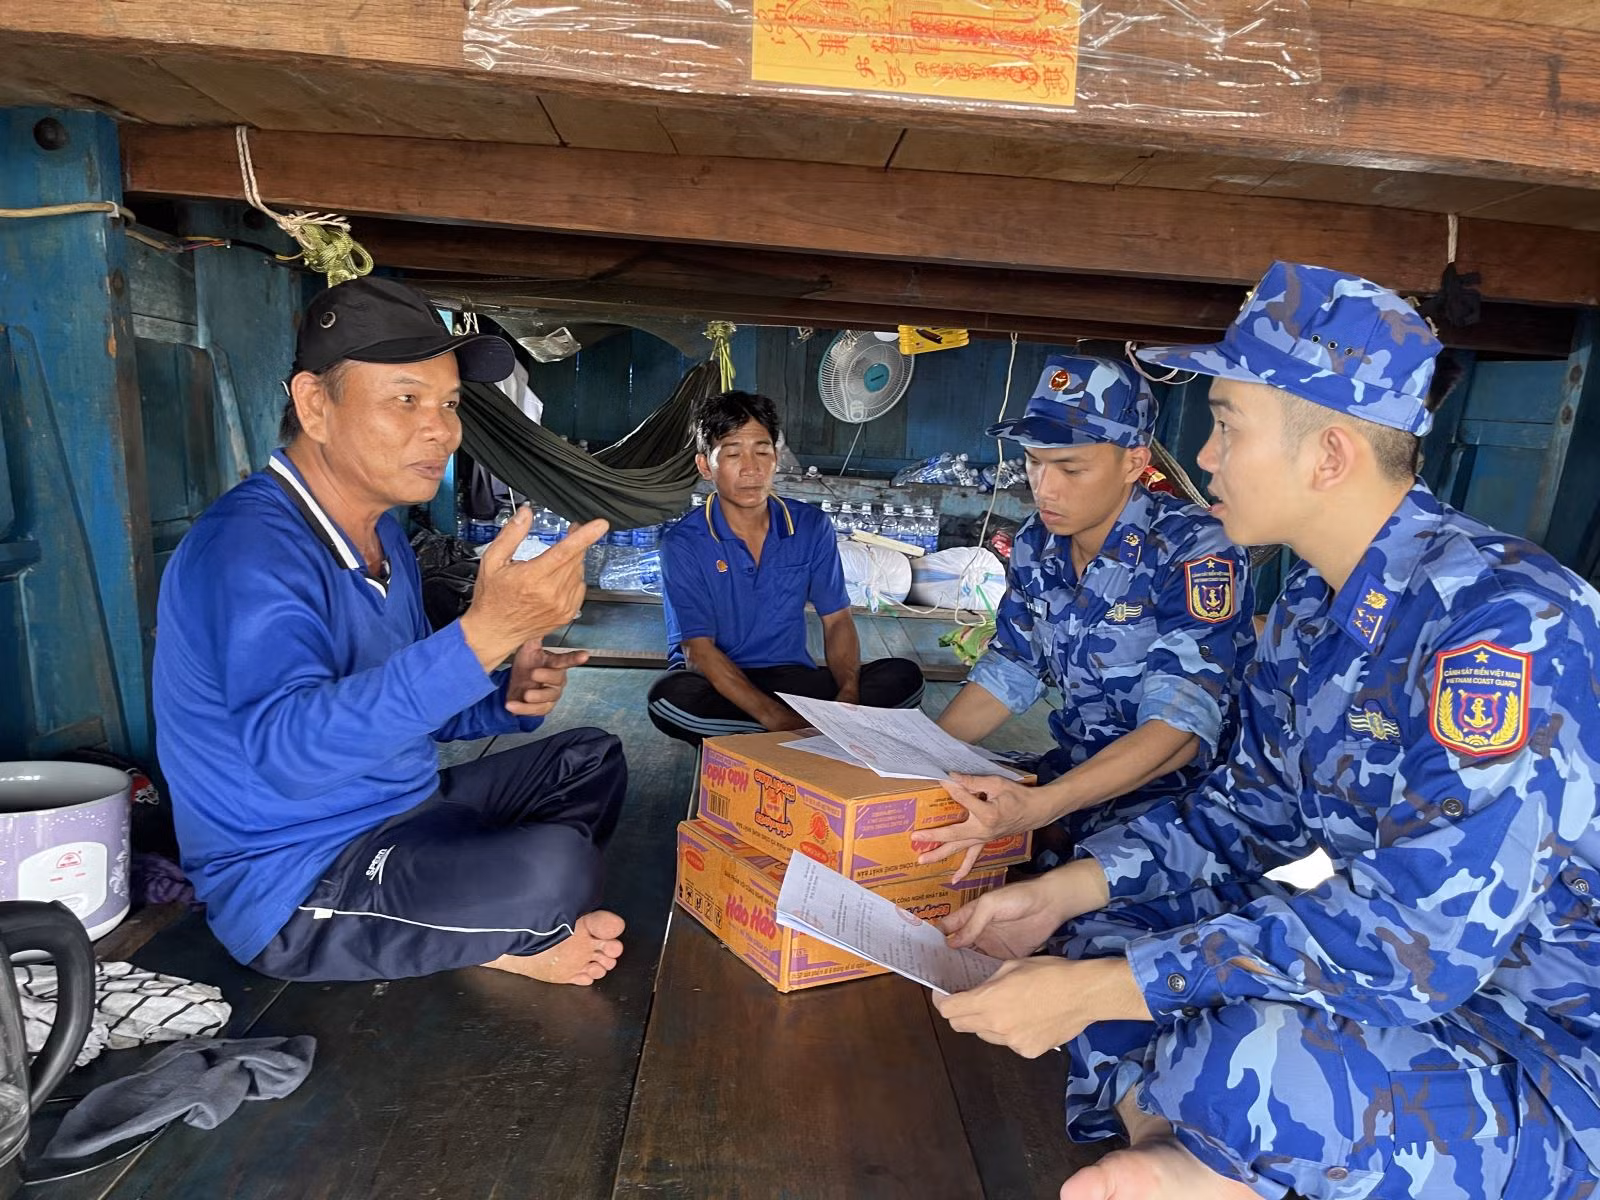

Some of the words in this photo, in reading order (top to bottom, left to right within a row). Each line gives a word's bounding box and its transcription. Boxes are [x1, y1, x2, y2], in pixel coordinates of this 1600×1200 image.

[1460, 667, 1473, 675] SÁT
[1490, 669, 1504, 677] VIỆT
[1473, 677, 1494, 685] COAST
[1495, 679, 1517, 688] GUARD
[726, 893, 749, 927] Hảo
[750, 904, 777, 940] Hảo
